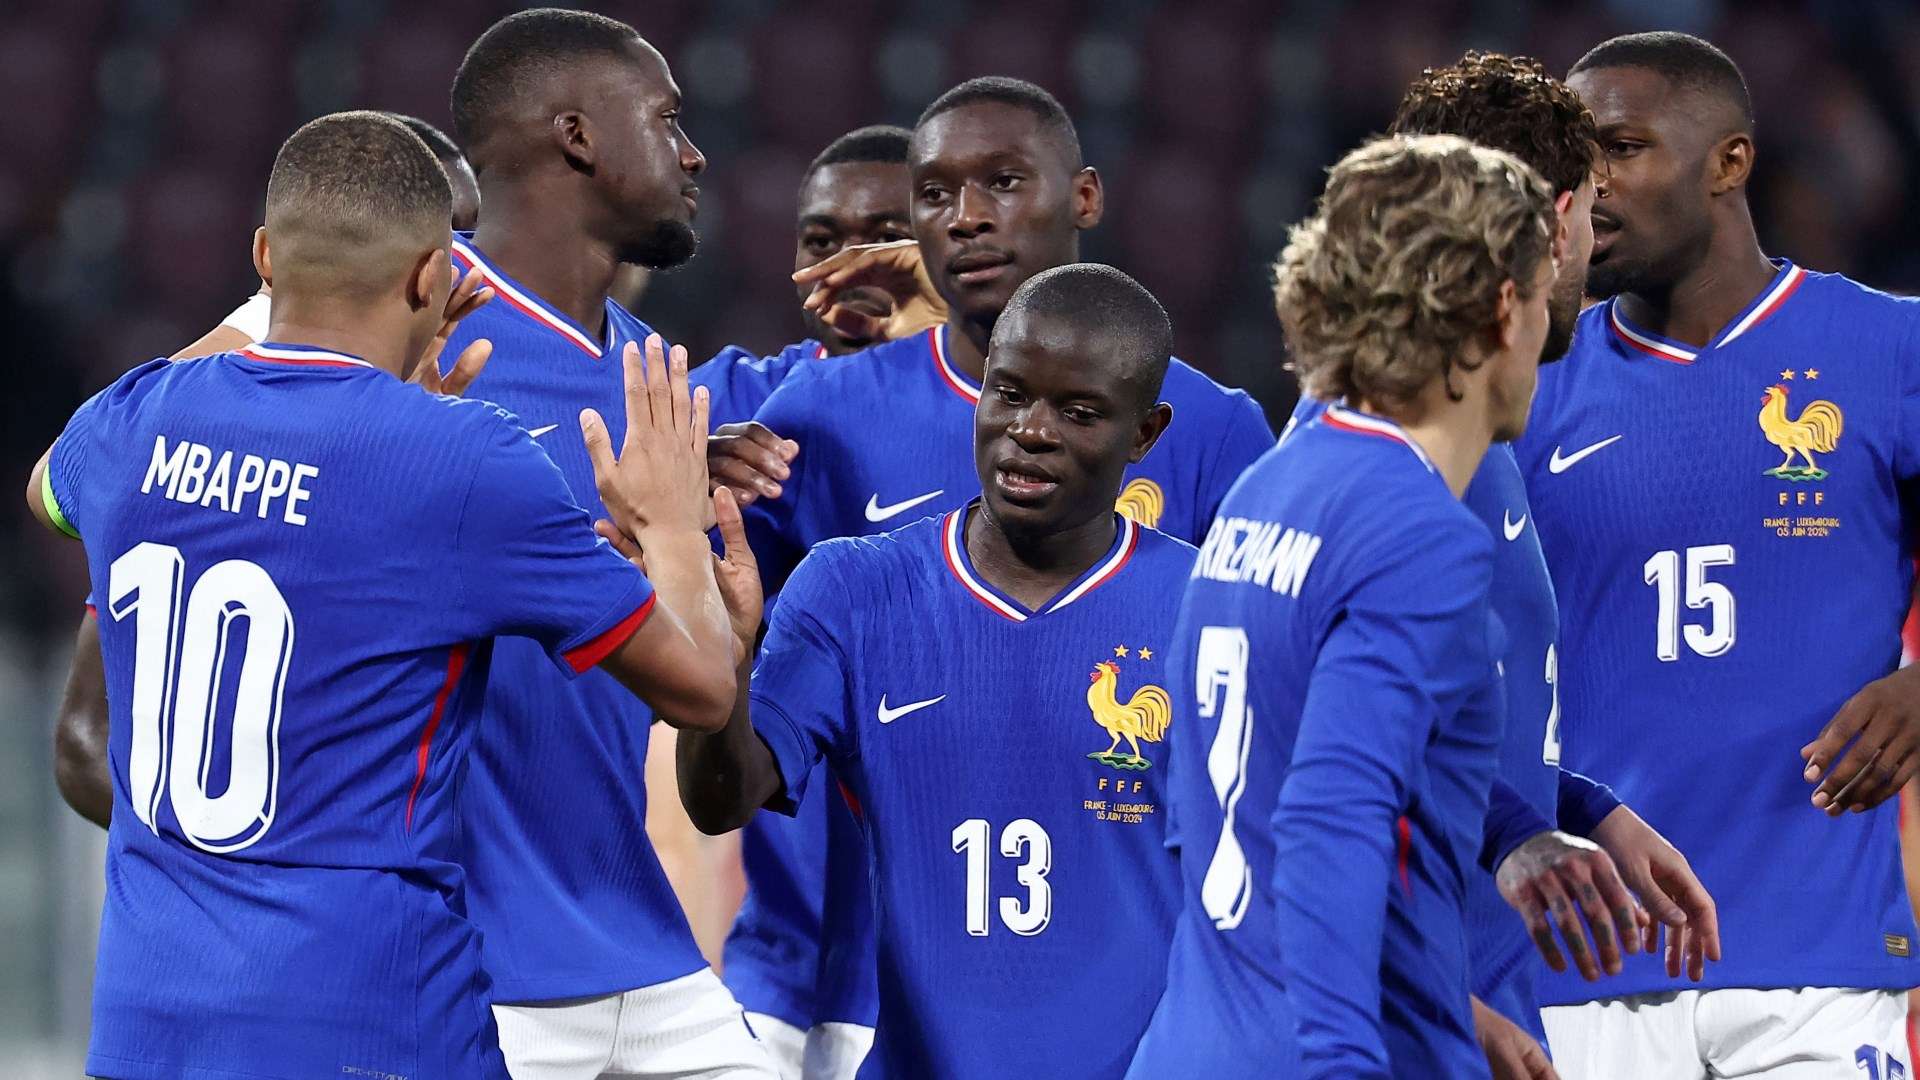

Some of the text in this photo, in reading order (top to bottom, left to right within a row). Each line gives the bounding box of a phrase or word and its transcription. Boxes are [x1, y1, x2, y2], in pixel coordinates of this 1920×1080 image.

[140, 435, 319, 526] MBAPPE
[1764, 518, 1790, 528] FRANCE
[1796, 518, 1840, 528] LUXEMBOURG
[1190, 516, 1322, 599] RIEZMANN
[1776, 527, 1829, 537] 05 JUIN 2024
[1644, 544, 1736, 662] 15
[109, 541, 295, 854] 10
[1084, 800, 1107, 810] FRANCE
[1113, 803, 1154, 813] LUXEMBOURG
[1096, 810, 1143, 823] 05 JUIN 2024
[1196, 626, 1253, 930] 7
[951, 818, 1052, 937] 13
